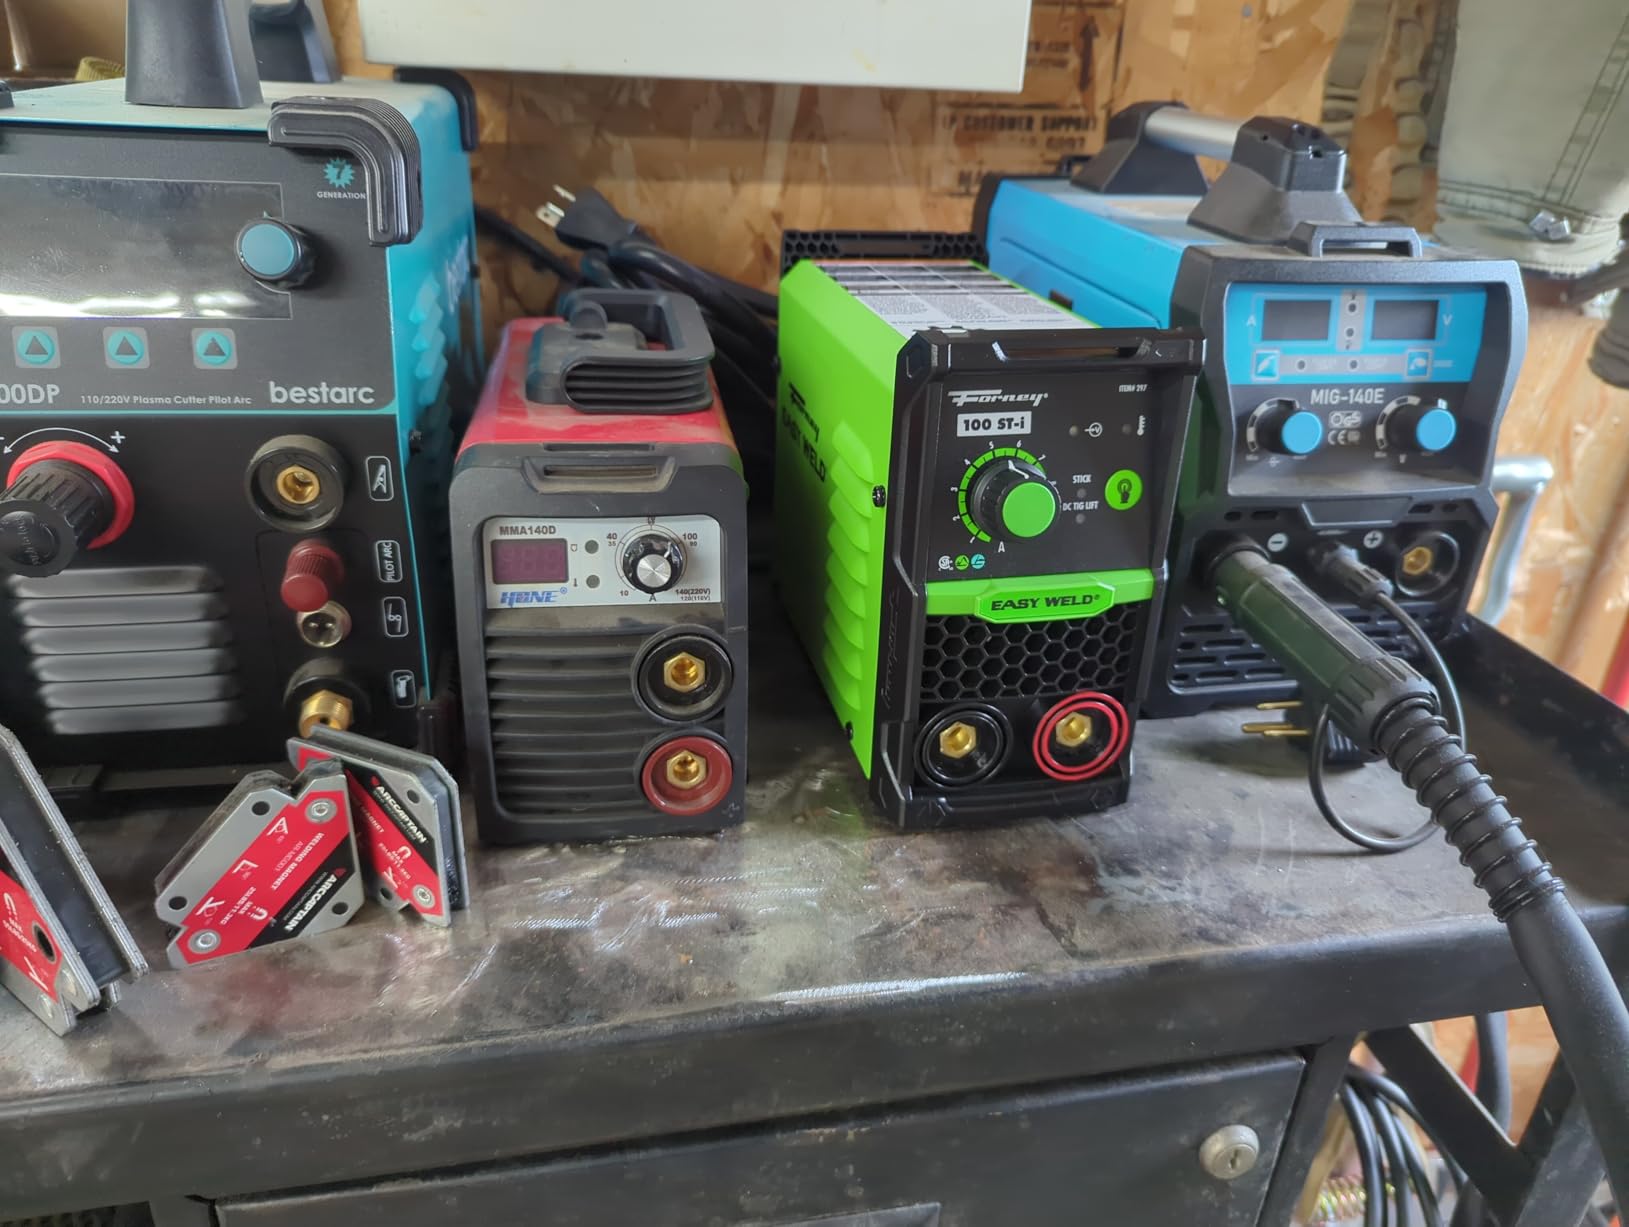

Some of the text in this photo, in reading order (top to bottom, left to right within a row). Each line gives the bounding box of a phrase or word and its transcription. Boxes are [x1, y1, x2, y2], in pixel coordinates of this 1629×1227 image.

[316, 191, 367, 200] GENERATION
[1443, 313, 1454, 326] V
[268, 380, 375, 404] bestarc
[947, 388, 1044, 407] Forney
[1310, 387, 1385, 405] MIG-140E
[80, 395, 253, 405] 110/220V Plasma Cutter Pilot Arc
[963, 416, 1025, 431] 100 ST-i
[988, 440, 994, 450] 5
[1016, 439, 1022, 448] 6
[1072, 474, 1092, 484] STICK
[1062, 500, 1099, 511] DC TIG LIFT
[499, 525, 557, 536] MMA140D
[606, 532, 617, 540] 40
[682, 532, 698, 541] 100
[997, 541, 1006, 553] A
[383, 541, 396, 581] PILOT ARC
[648, 594, 657, 602] A
[991, 594, 1094, 611] EASY WELD
[376, 786, 427, 843] ARCCAPTAIN
[271, 832, 325, 891] WELDING MAGNET
[284, 874, 337, 931] ARCCAPTAIN
